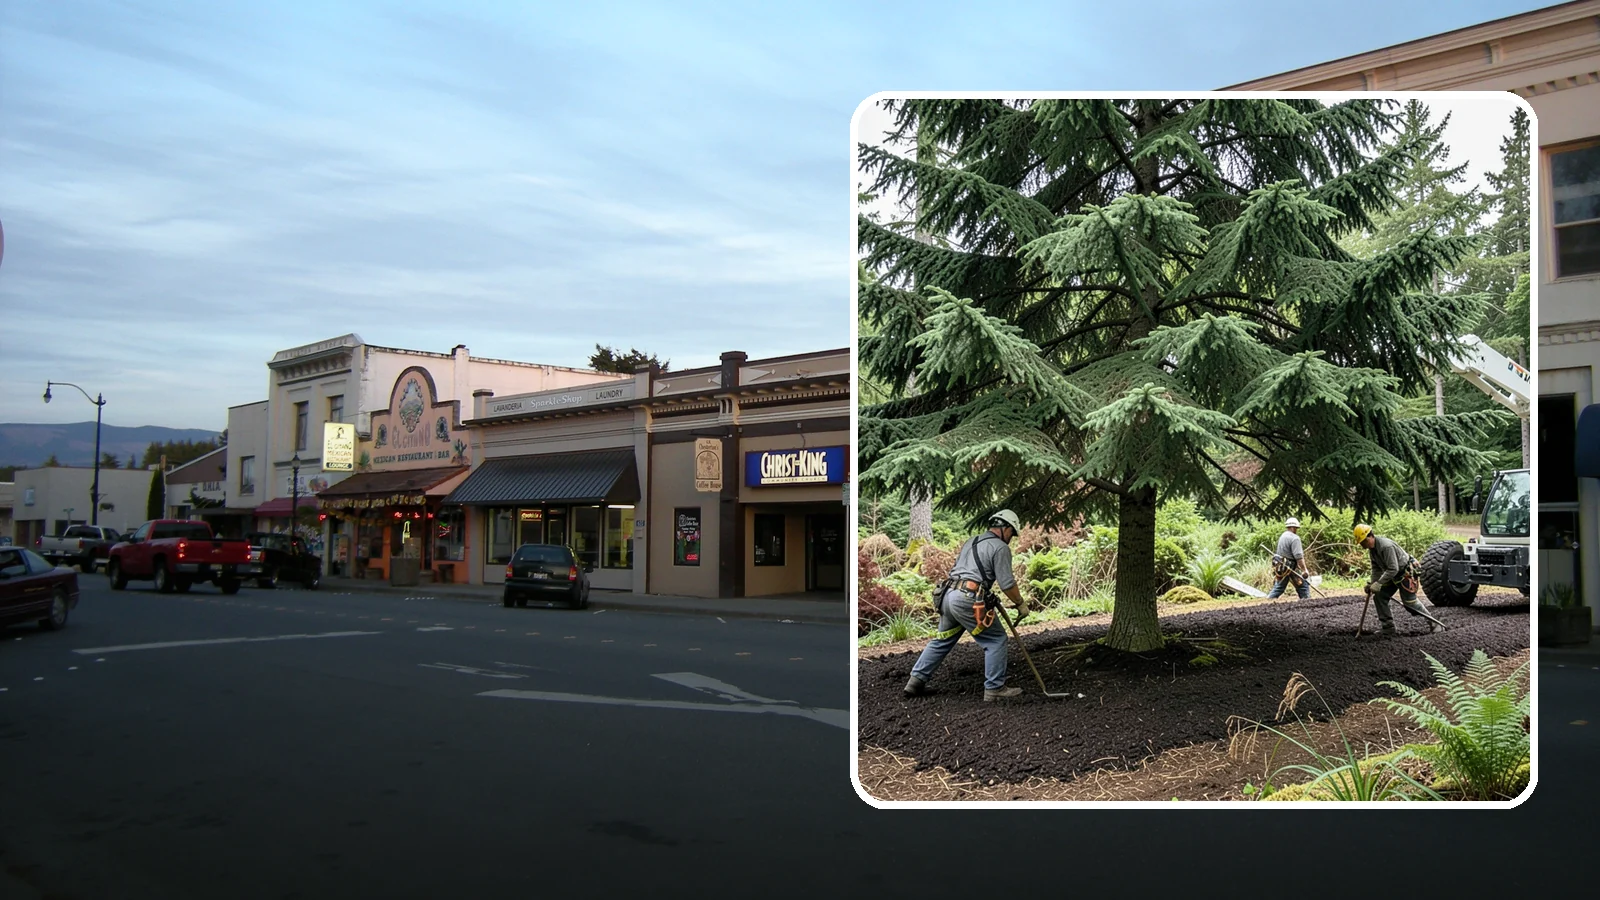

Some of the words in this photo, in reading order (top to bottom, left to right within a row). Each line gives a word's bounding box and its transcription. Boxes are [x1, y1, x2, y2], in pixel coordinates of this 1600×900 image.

[595, 389, 623, 400] LAUNDRY
[493, 402, 522, 413] LAVANDERIA
[373, 454, 396, 464] MEXICAN
[397, 451, 434, 463] RESTAURANT
[437, 450, 450, 459] BAR
[760, 452, 797, 478] CHRIST
[799, 450, 828, 477] KING
[696, 480, 709, 488] Coffee
